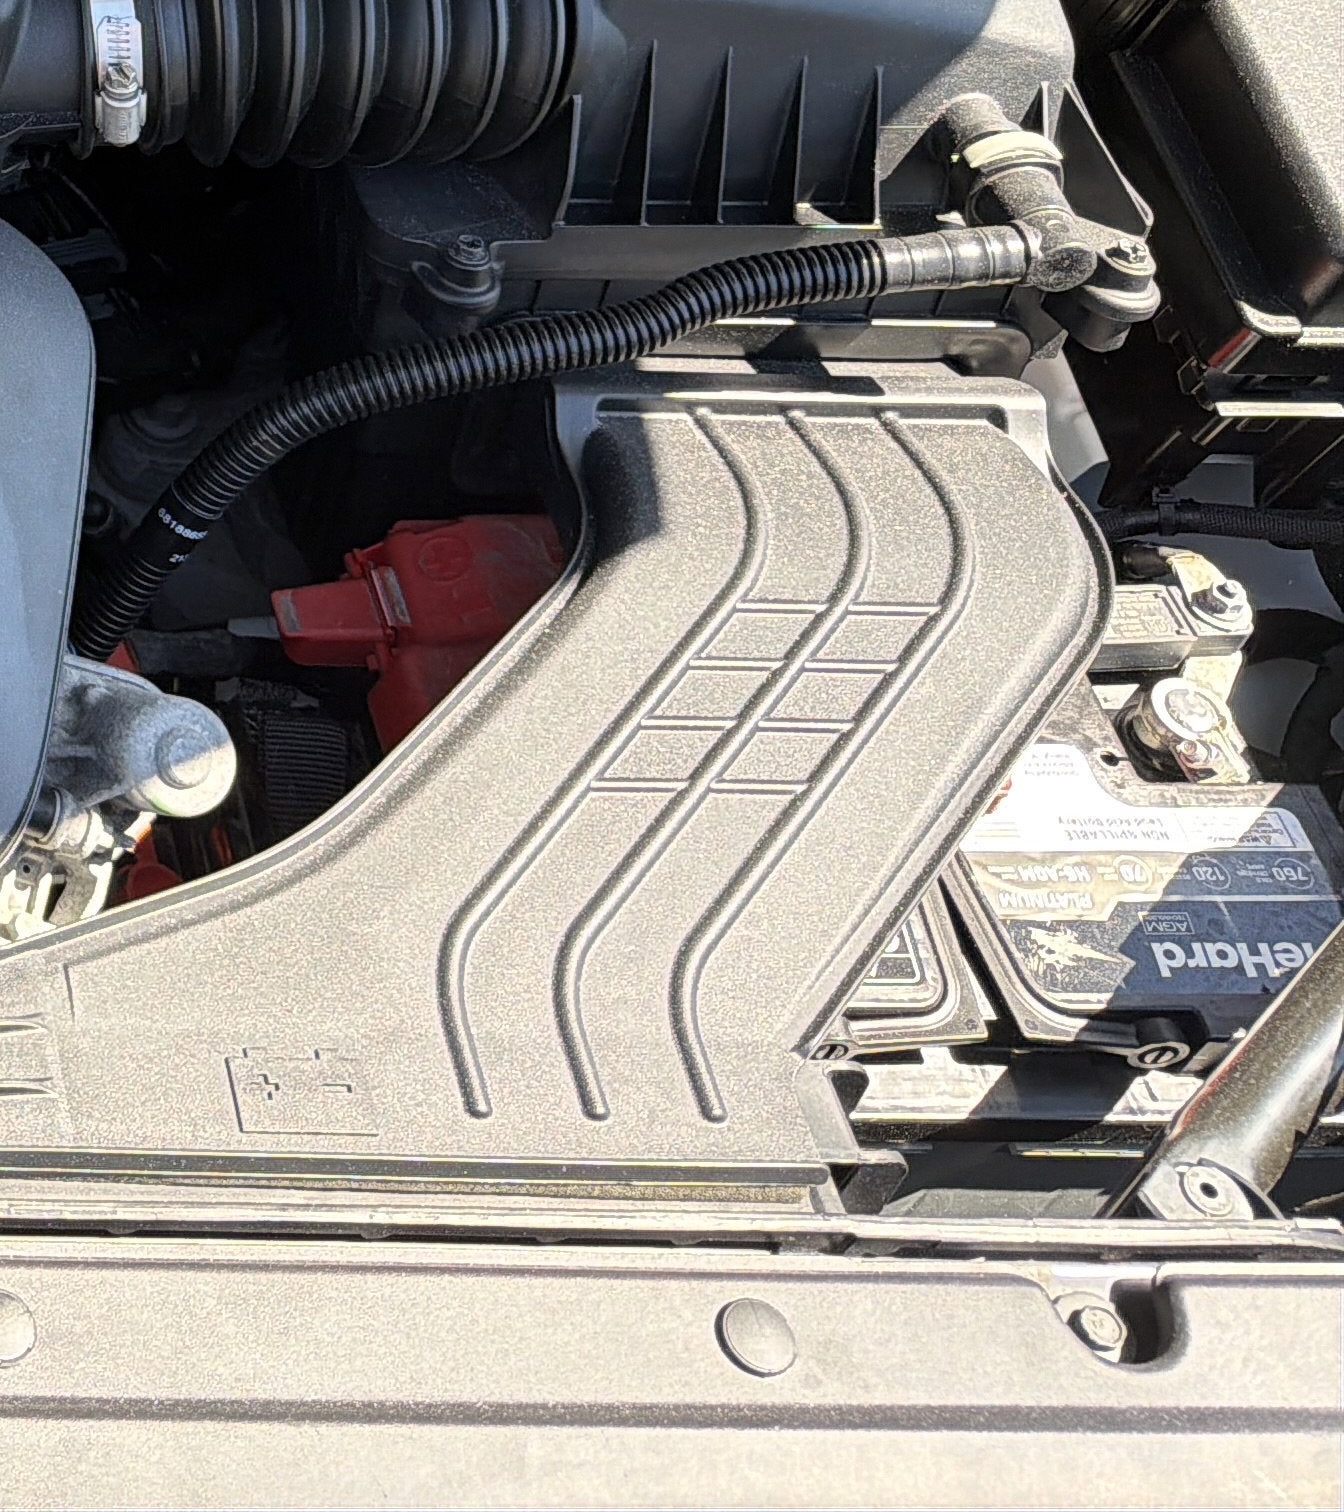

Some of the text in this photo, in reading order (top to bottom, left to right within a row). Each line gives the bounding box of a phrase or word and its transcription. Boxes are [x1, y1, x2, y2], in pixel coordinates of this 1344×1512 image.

[1191, 866, 1226, 881] 120
[1272, 867, 1309, 881] 760
[998, 891, 1093, 909] PLATINUM
[1146, 921, 1188, 933] AGM
[1150, 941, 1316, 978] eHard
